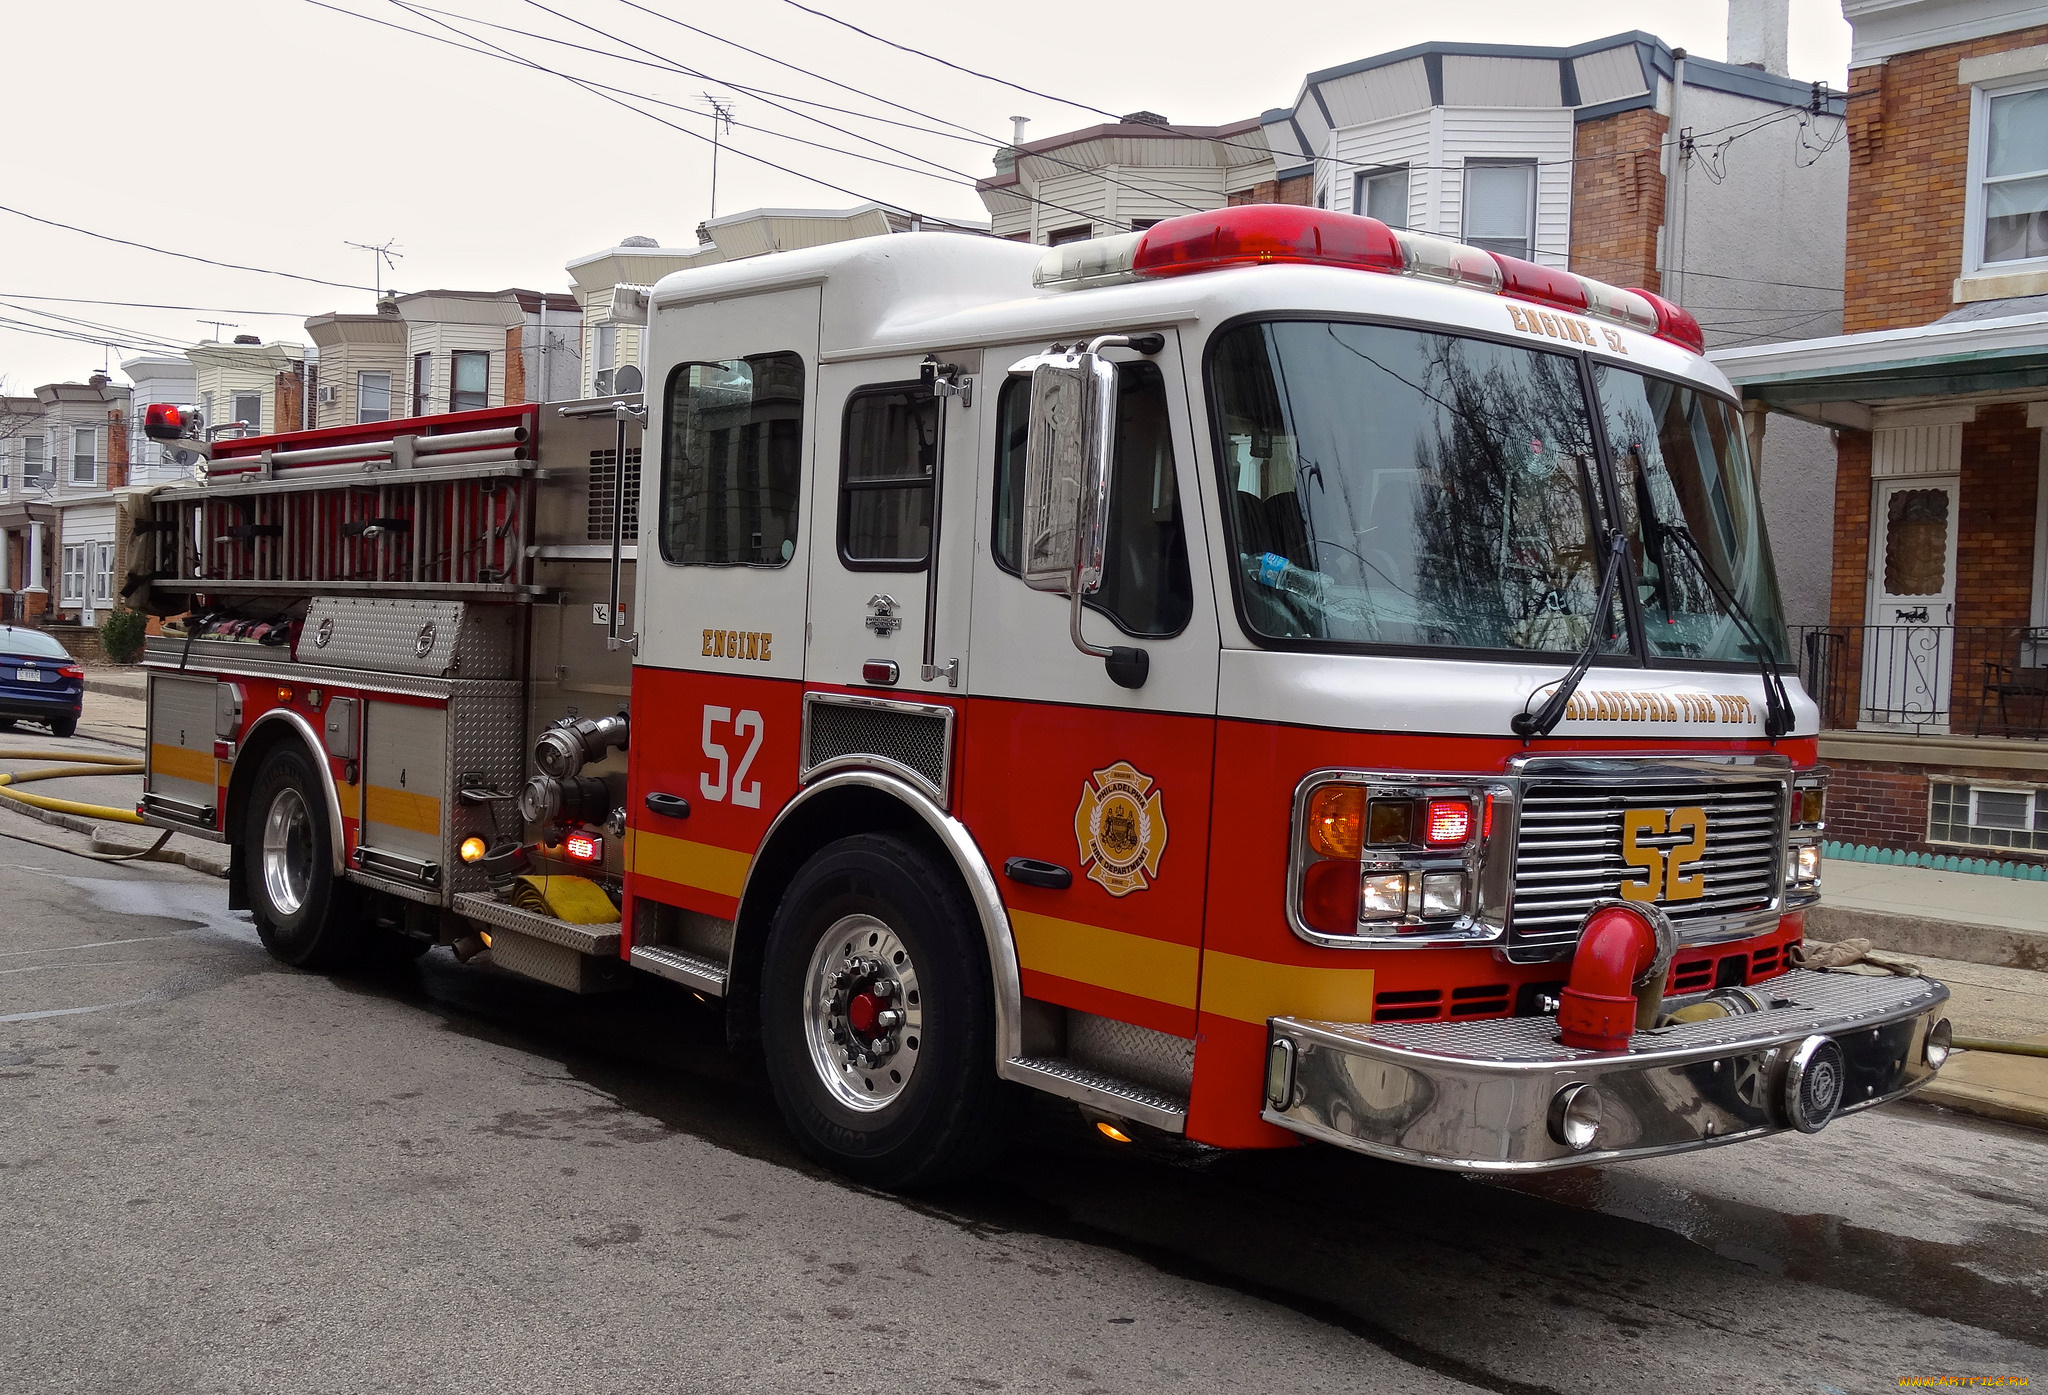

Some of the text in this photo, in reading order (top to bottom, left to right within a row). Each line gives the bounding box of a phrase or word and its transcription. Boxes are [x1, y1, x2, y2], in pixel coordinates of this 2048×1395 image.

[1505, 304, 1628, 355] ENGINE 52
[702, 629, 772, 661] ENGINE
[1545, 690, 1756, 724] HILADELPHIA FIRE DEPT.
[180, 729, 185, 746] 5
[700, 704, 764, 809] 52
[400, 768, 406, 788] 4
[1097, 783, 1146, 808] PHILADELPHIA
[1091, 842, 1147, 874] FIRE DEPARTMENT
[1620, 807, 1708, 902] 52
